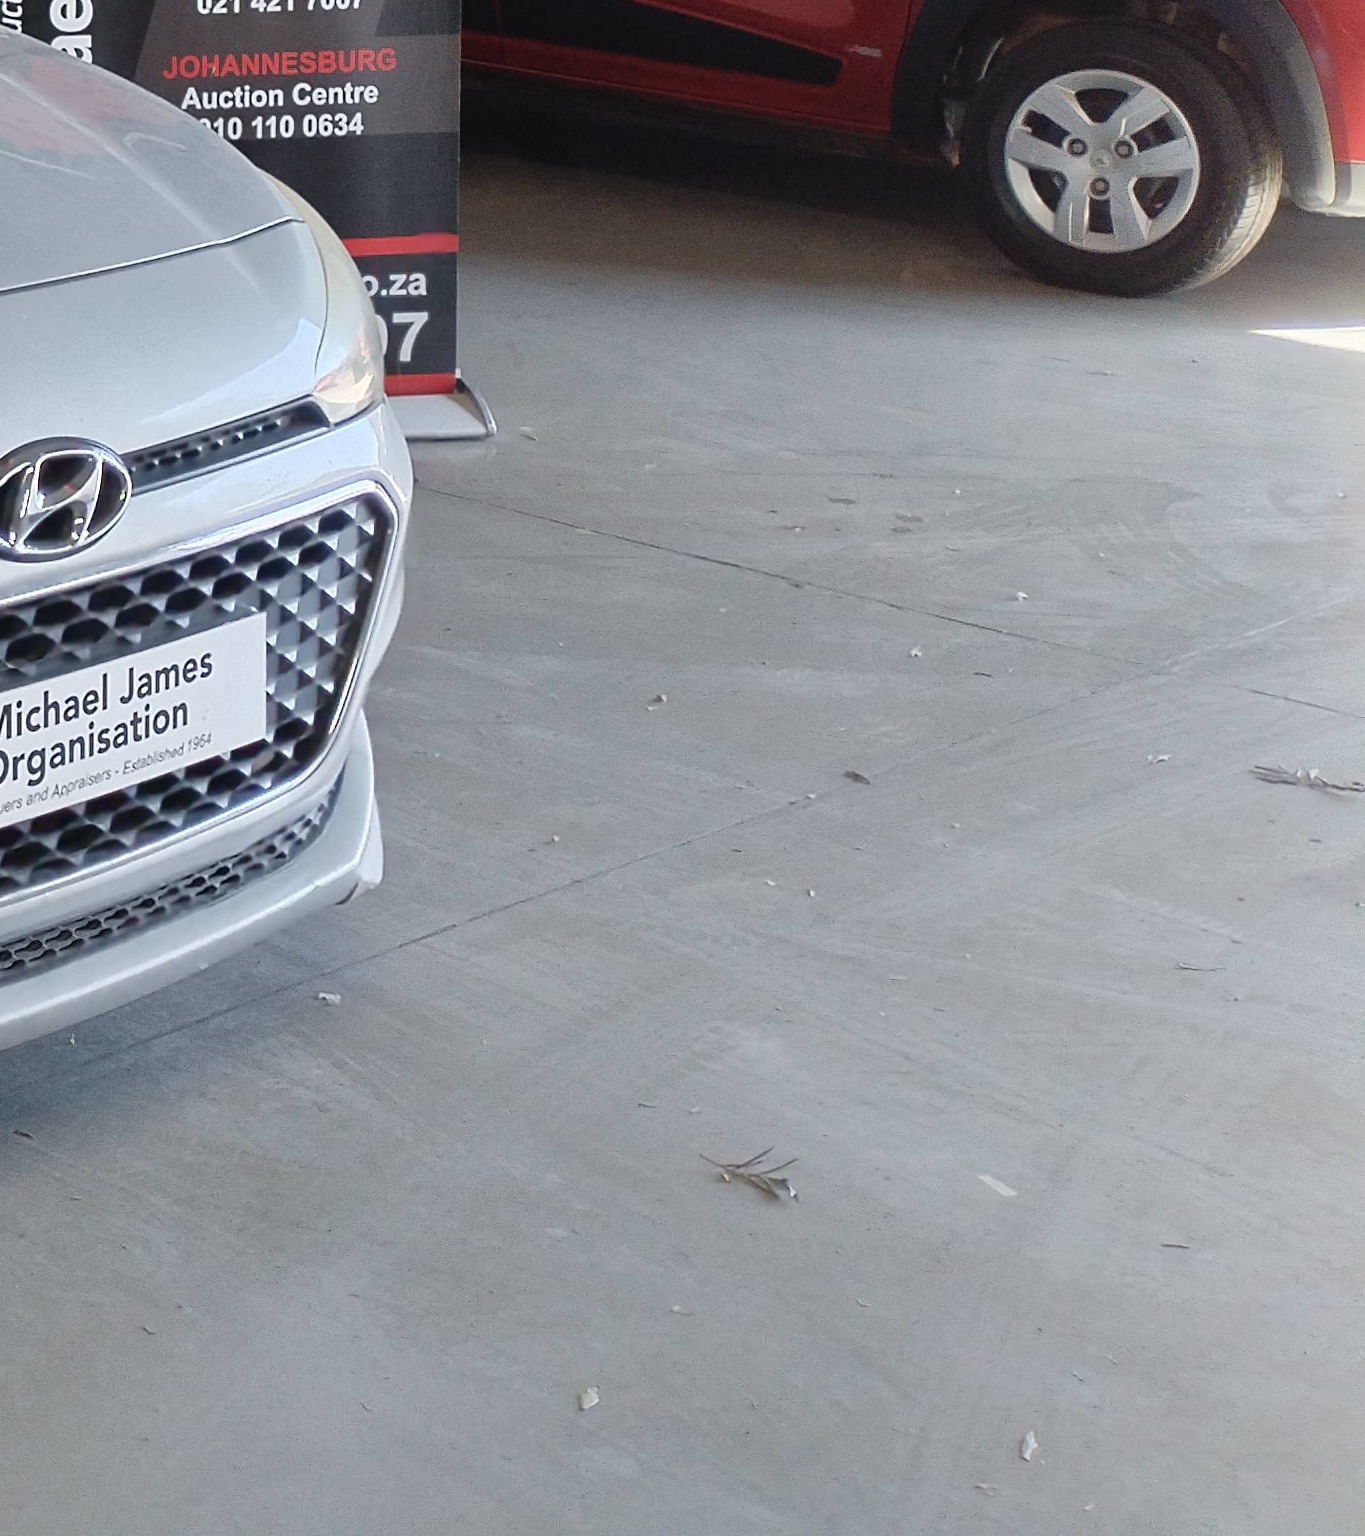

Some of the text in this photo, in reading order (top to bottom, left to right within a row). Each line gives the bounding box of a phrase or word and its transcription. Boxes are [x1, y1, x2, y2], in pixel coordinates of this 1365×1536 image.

[162, 48, 396, 79] JOHANNESBURG
[180, 81, 379, 110] Auction Centre
[251, 114, 295, 139] 110
[302, 111, 365, 138] 0634
[119, 649, 214, 707] James
[25, 788, 49, 807] and
[51, 768, 112, 799] Appraisers
[121, 742, 186, 775] Established
[187, 732, 212, 751] 1964
